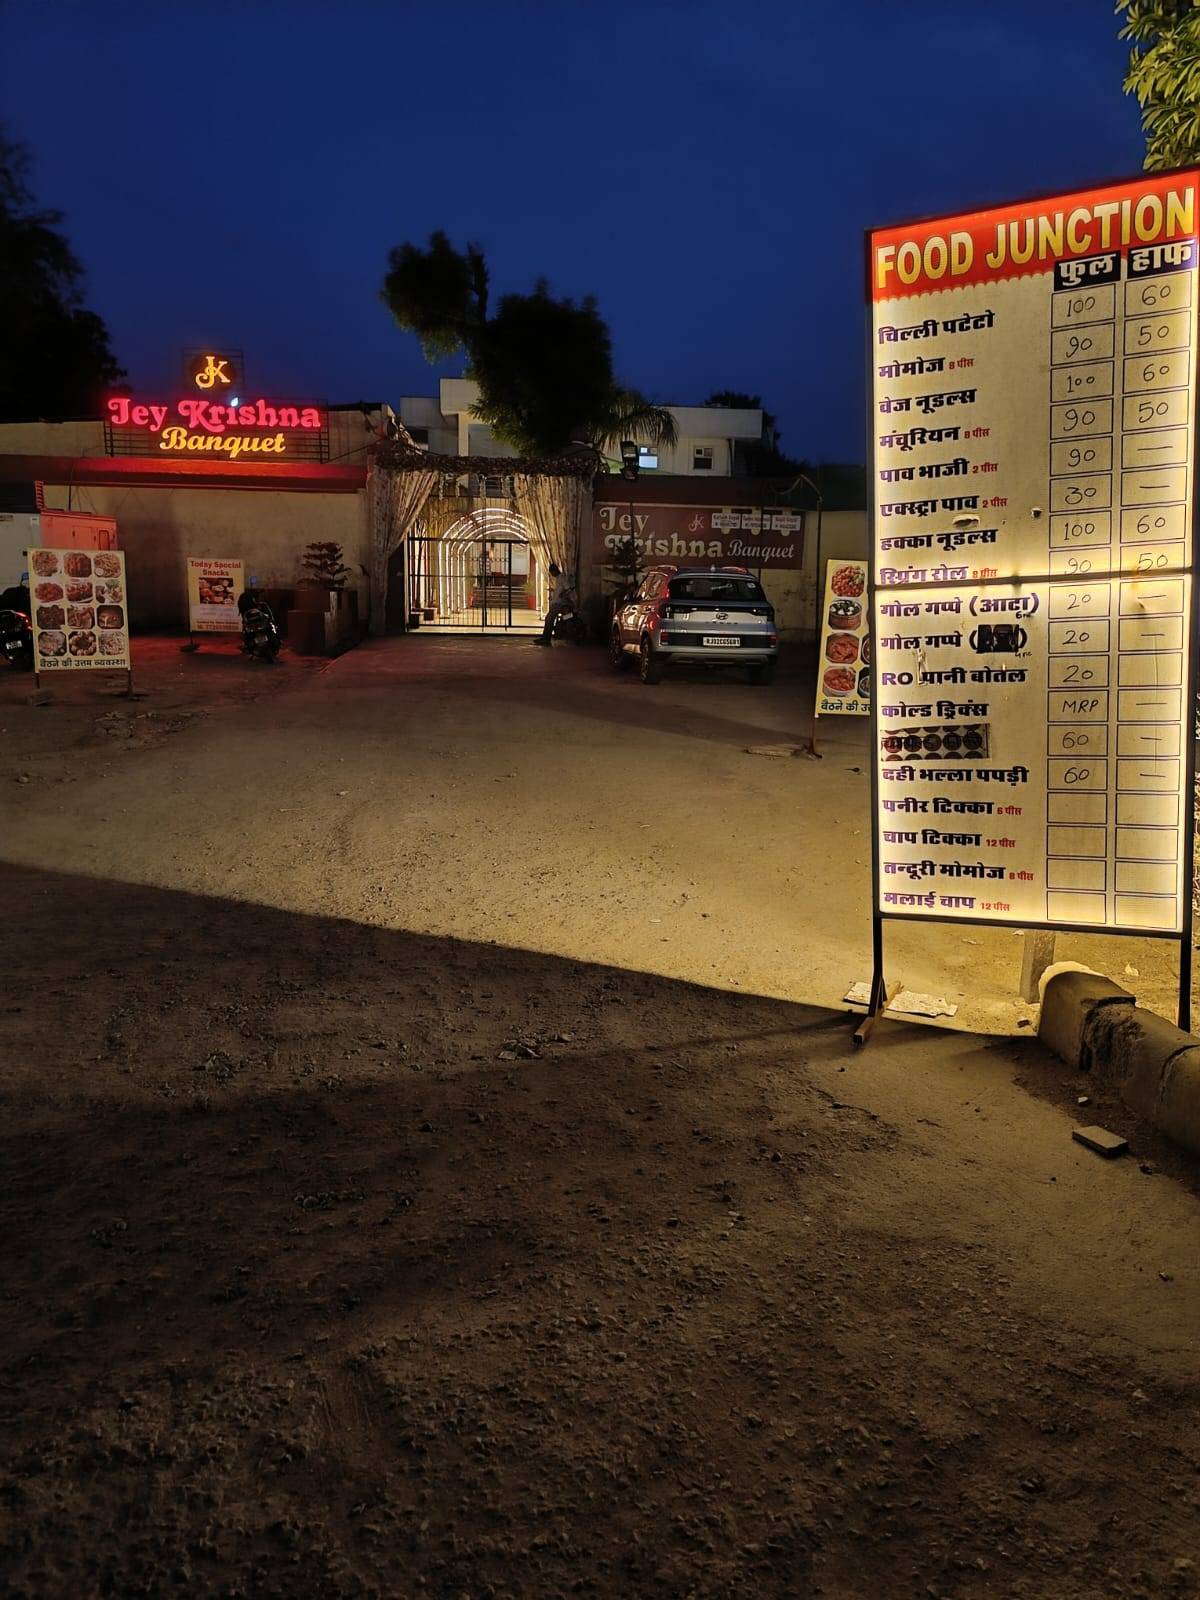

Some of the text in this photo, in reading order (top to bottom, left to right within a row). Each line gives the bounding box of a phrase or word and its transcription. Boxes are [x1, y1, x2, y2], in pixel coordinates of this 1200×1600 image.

[876, 187, 1195, 289] FOOD JUNCTION
[1131, 240, 1193, 271] हाफ
[1059, 254, 1113, 286] फुल
[1141, 285, 1171, 306] 60
[1066, 296, 1096, 318] 100
[878, 309, 995, 344] चिल्ली पटेटो
[1138, 325, 1169, 346] 50
[1066, 336, 1092, 358] 90
[878, 356, 975, 378] मोमोज 8 पीस
[1142, 363, 1170, 382] 60
[1067, 368, 1095, 394] 100
[879, 388, 977, 414] वेज नूडल्स
[107, 398, 321, 433] Jey Krishna
[1063, 408, 1096, 432] 90
[1138, 401, 1169, 424] 50
[160, 427, 286, 458] Banquet
[879, 427, 990, 451] मंचूरियन 8 पीस
[1068, 448, 1096, 467] 90
[880, 458, 998, 482] पाव भाजी 2 पीस
[880, 495, 1008, 517] एक्स्ट्रा पाव 2 पीस
[1064, 486, 1097, 505] 30
[600, 507, 649, 534] Jey
[1136, 514, 1166, 534] 60
[880, 529, 998, 551] हक्का नूडल्स
[1064, 522, 1096, 541] 100
[728, 539, 795, 562] Banquet
[191, 561, 241, 570] Today Special
[931, 564, 969, 580] रोल
[1065, 557, 1092, 575] 90
[1137, 552, 1169, 572] 50
[880, 600, 922, 617] गोल
[925, 597, 963, 615] गप्पे
[1067, 593, 1092, 610] 20
[880, 633, 921, 650] गोल
[925, 629, 963, 648] गप्पे
[1062, 629, 1090, 646] 20
[882, 666, 1028, 685] RO पानी बोतल
[1062, 665, 1094, 683] 20
[846, 699, 859, 711] की
[881, 701, 933, 717] कोल्ड
[1062, 699, 1098, 713] MRP
[1062, 731, 1089, 749] 60
[882, 765, 1029, 786] दही भल्ला पपड़ी
[1064, 767, 1090, 784] 60
[883, 797, 929, 814] पनीर
[933, 798, 994, 814] टिक्का
[1004, 804, 1022, 815] पीस
[883, 829, 1015, 848] चाप टिक्का 12 पीस
[884, 860, 1034, 881] तन्दूरी मोमोज 8 पीस
[884, 892, 1010, 911] मलाई चाप 12 पीस
